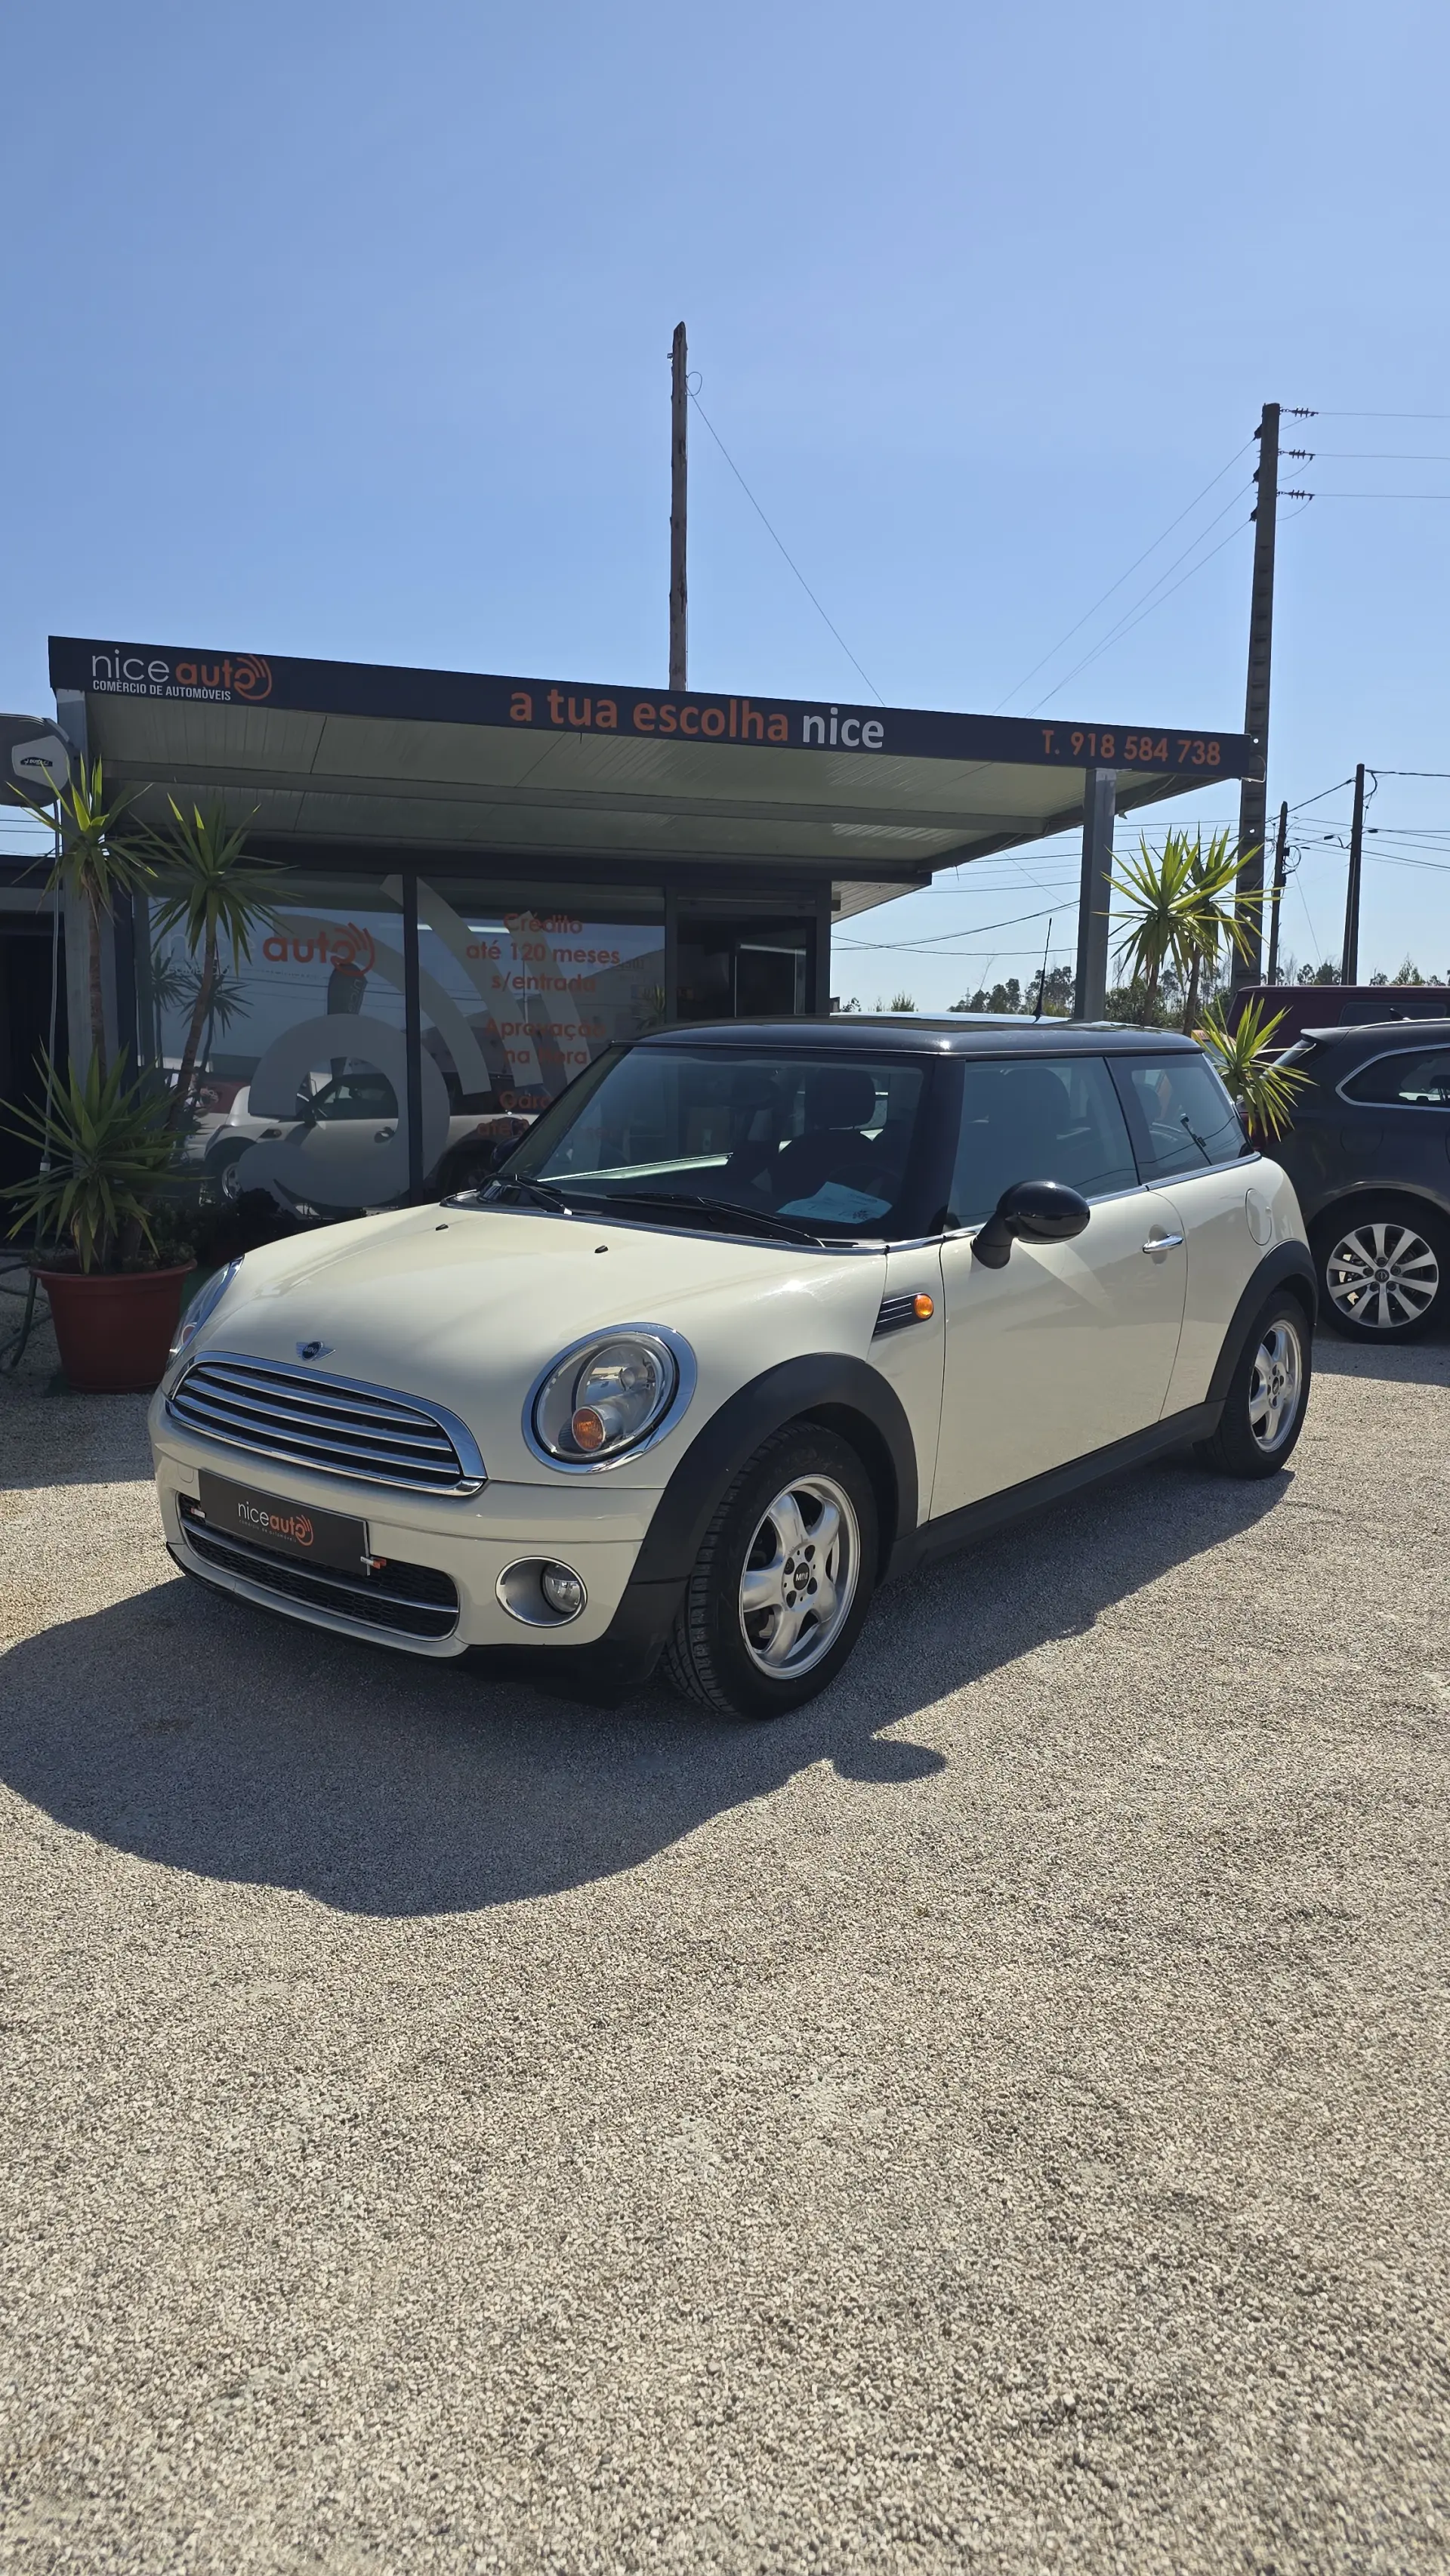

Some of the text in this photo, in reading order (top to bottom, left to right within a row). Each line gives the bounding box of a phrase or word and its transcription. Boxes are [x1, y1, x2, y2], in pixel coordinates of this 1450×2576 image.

[91, 649, 170, 683] nice
[150, 684, 163, 696] DE
[509, 688, 885, 749] a tua escolha nice
[1042, 729, 1221, 766] T. 918 584 738
[503, 912, 583, 934] Crédito
[465, 939, 501, 960] até
[511, 942, 546, 962] 120
[552, 948, 622, 965] meses
[491, 971, 597, 993] s/entrada
[485, 1017, 606, 1040] Aprovação
[504, 1049, 530, 1064] na
[795, 1572, 809, 1582] MINI
